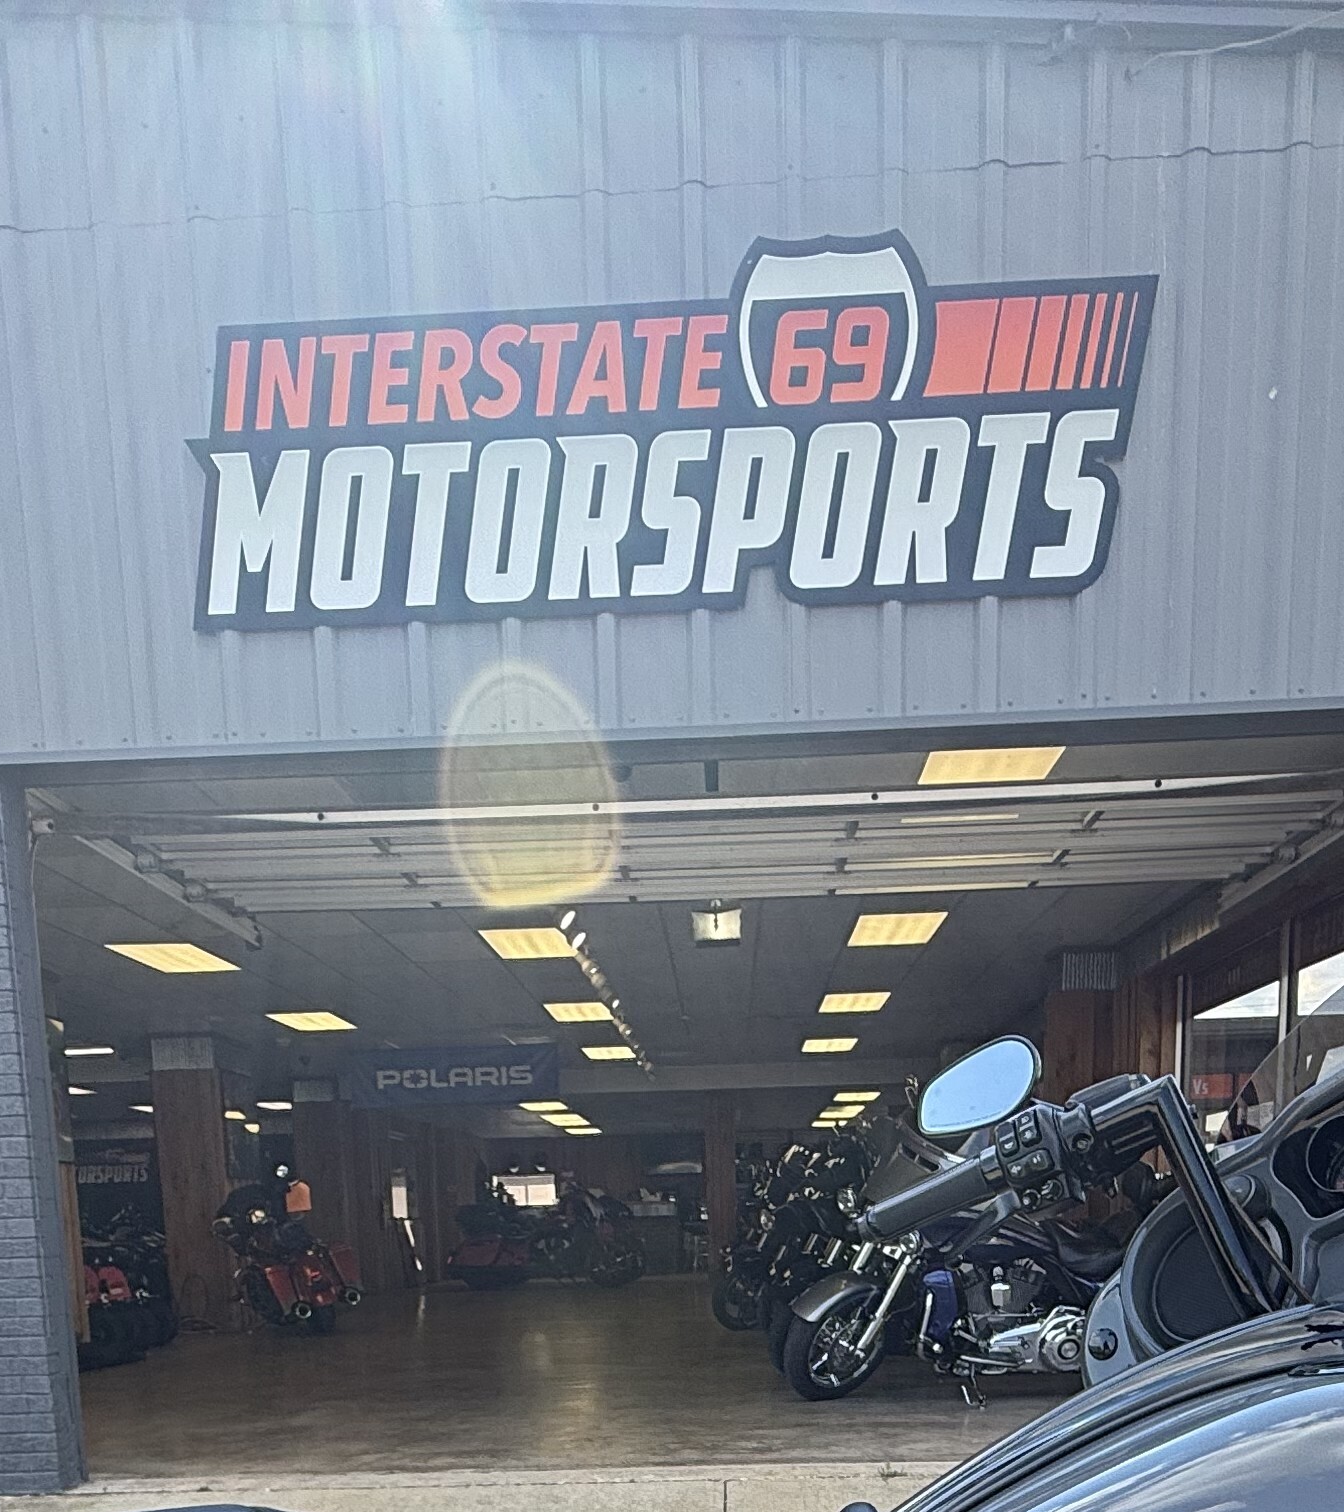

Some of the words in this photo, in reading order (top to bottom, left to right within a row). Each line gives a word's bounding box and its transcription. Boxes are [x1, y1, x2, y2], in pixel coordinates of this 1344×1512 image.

[224, 314, 729, 433] INTERSTATE
[769, 306, 891, 404] 69
[208, 408, 1121, 616] MOTORSPORTS
[376, 1065, 534, 1090] POLARIS
